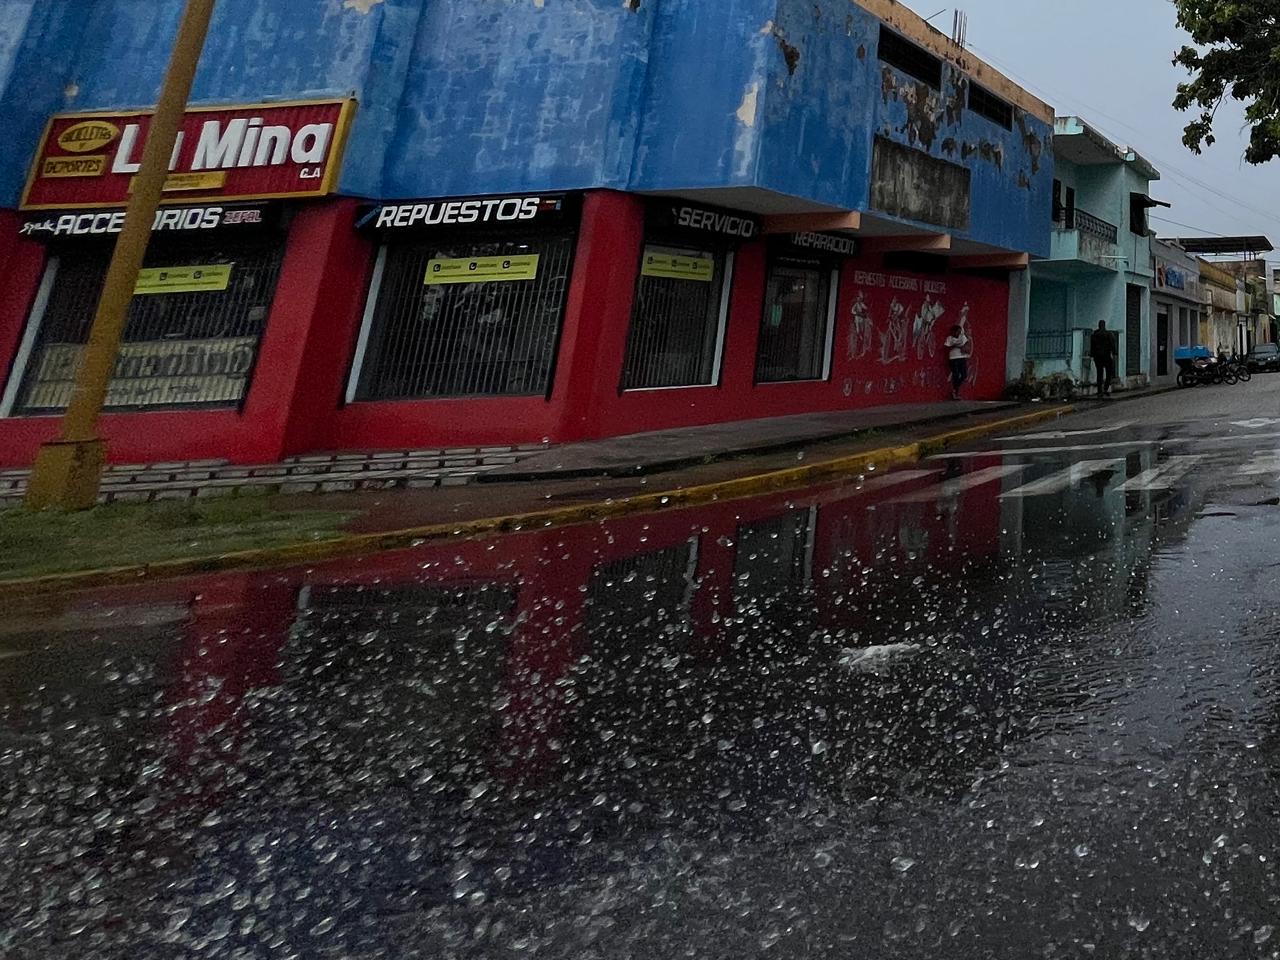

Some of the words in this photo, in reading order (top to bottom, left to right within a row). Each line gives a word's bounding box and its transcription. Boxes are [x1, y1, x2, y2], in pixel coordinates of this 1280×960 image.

[111, 123, 185, 173] L
[191, 117, 333, 171] Mina
[44, 159, 103, 174] DEPORTES
[54, 207, 223, 235] ACCERIOS
[376, 197, 540, 228] REPUESTOS
[678, 206, 755, 238] SERVICIO
